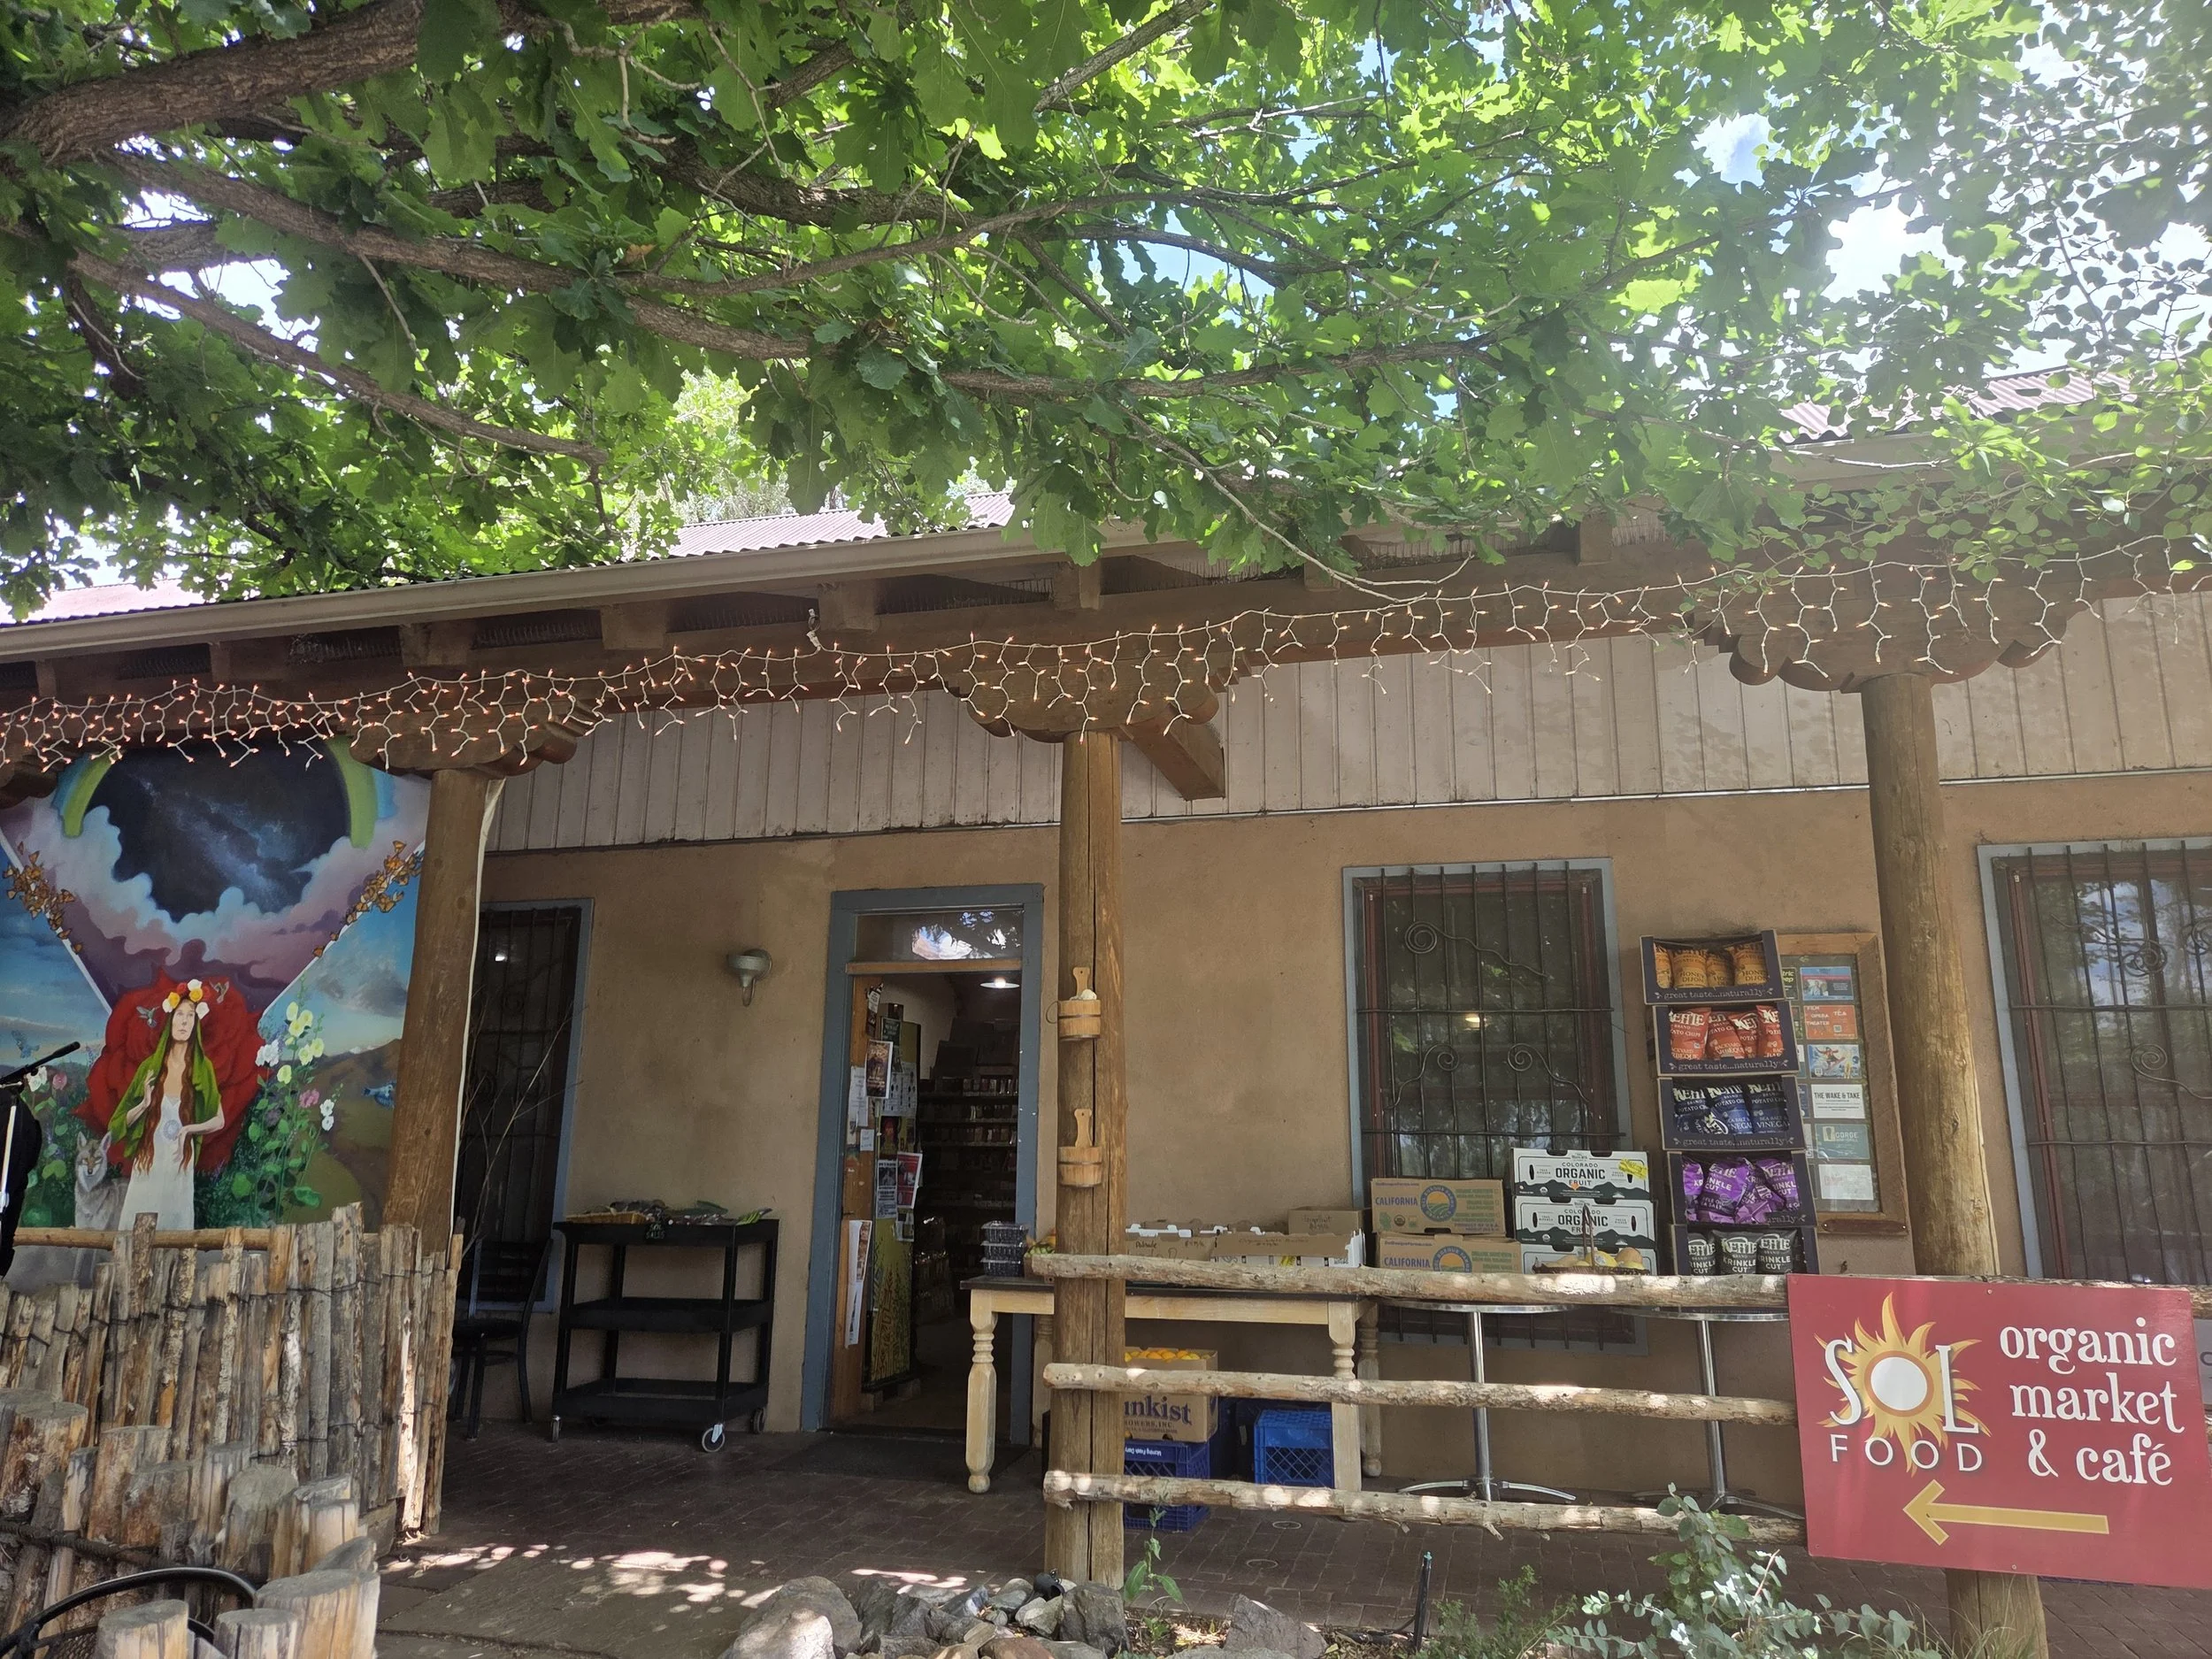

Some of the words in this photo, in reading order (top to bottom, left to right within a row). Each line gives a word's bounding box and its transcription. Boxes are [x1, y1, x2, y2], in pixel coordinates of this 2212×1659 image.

[1663, 991, 1688, 1001] great
[1678, 1063, 1703, 1071] great
[1555, 1167, 1606, 1179] ORGANIC
[1375, 1196, 1418, 1206] CALIFORNIA
[1557, 1214, 1609, 1227] ORGNIC
[1687, 1242, 1716, 1256] ETTLE
[1759, 1237, 1792, 1251] ETTLE
[1384, 1256, 1431, 1269] CALIFORNIA
[2000, 1317, 2177, 1375] organic
[2008, 1371, 2185, 1434] market
[1830, 1433, 1983, 1473] FOOD
[2027, 1428, 2059, 1478] &
[2076, 1432, 2174, 1486] café
